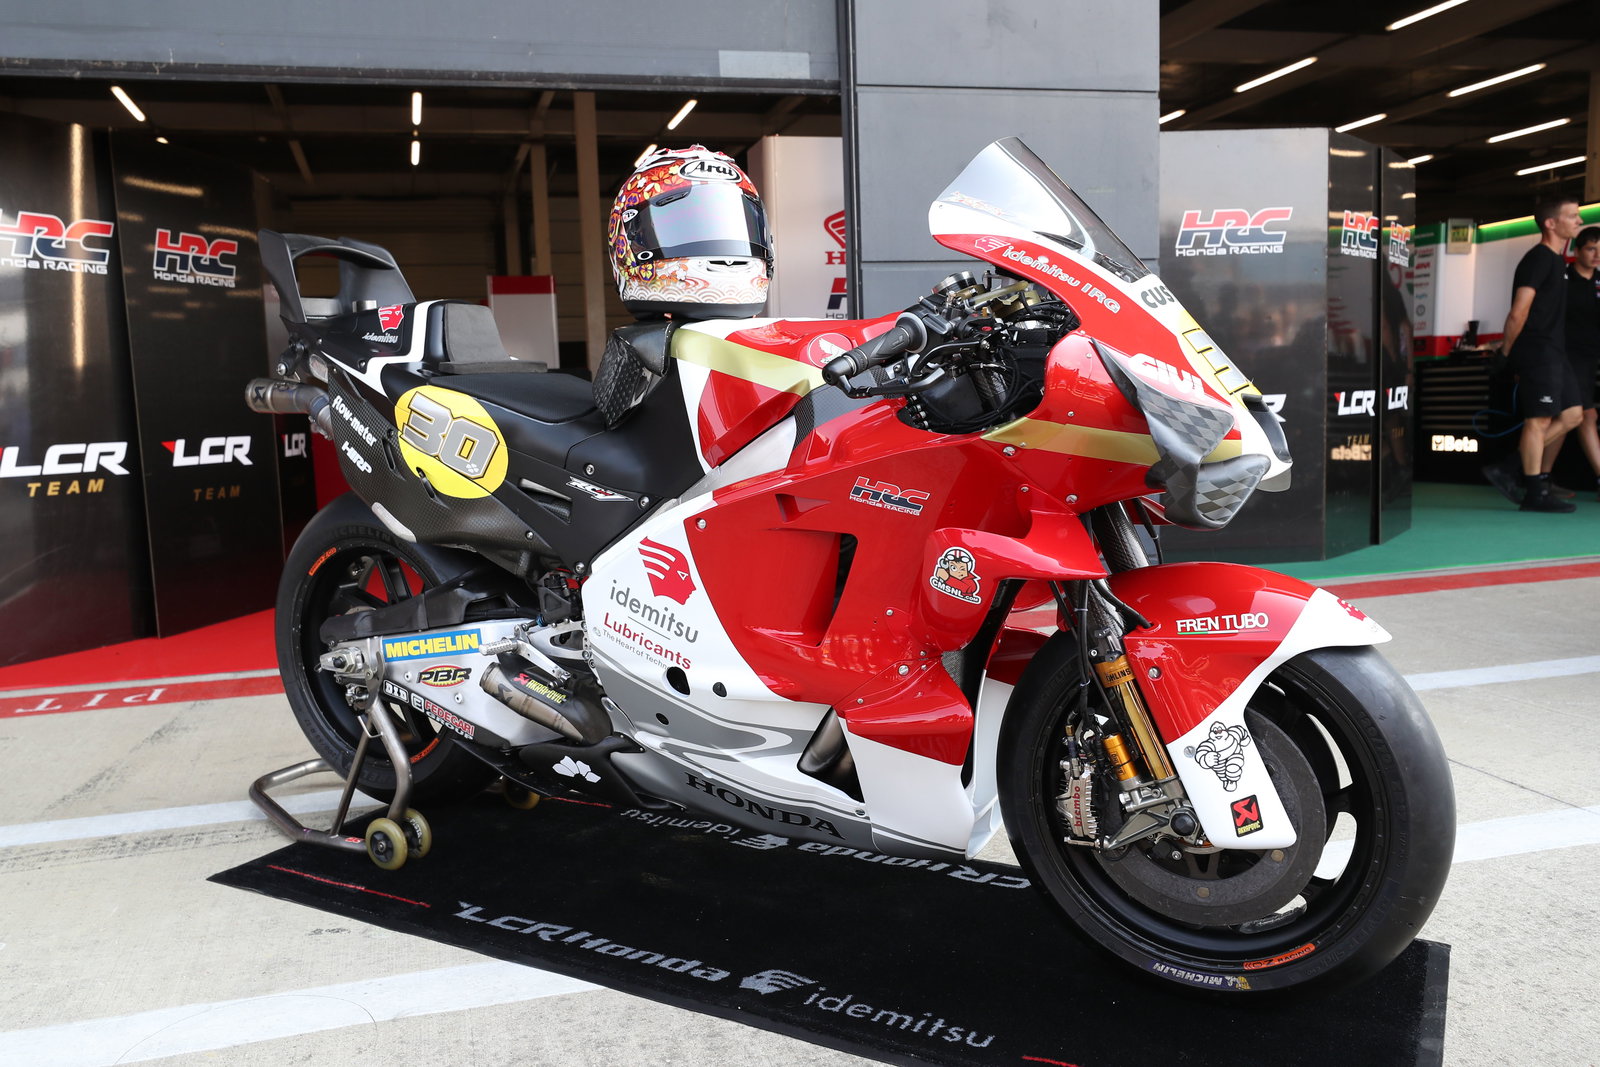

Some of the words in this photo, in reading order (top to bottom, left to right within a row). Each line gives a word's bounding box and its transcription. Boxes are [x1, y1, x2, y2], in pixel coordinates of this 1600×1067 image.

[686, 161, 734, 177] Arai
[1175, 206, 1293, 249] HRC
[1340, 210, 1379, 251] HRC
[153, 228, 238, 279] HRC
[1176, 247, 1227, 257] Honda
[1229, 245, 1284, 255] RACING
[43, 259, 108, 275] RACING
[154, 270, 195, 284] Honda
[196, 275, 236, 288] RACING
[1002, 245, 1081, 287] idemitsu
[1081, 283, 1121, 314] IRG
[362, 331, 399, 344] idemitsu
[1338, 390, 1376, 417] LCR
[1388, 386, 1409, 411] LCR
[332, 395, 377, 447] flow-meter
[284, 433, 307, 459] LCR
[400, 391, 500, 480] 30
[0, 442, 130, 478] LCR
[172, 436, 253, 467] LCR
[27, 478, 105, 498] TEAM
[193, 485, 241, 501] TEAM
[850, 476, 930, 512] HRC
[850, 495, 882, 508] Honda
[883, 503, 920, 516] RACING
[609, 579, 699, 643] idemitsu
[1176, 614, 1220, 632] FREN
[1222, 612, 1269, 630] TUBO
[384, 633, 480, 659] MICHELIN
[602, 629, 615, 642] The
[615, 637, 636, 655] Heart
[604, 612, 692, 670] Lubricants
[416, 667, 472, 683] PBR
[14, 688, 167, 713] PIT
[425, 700, 475, 736] FEDEGARI
[426, 711, 474, 740] GROUP
[684, 771, 846, 840] HONDA
[1073, 786, 1082, 827] brembo
[620, 808, 742, 840] idemitsu
[797, 840, 1032, 890] CRHonda
[1277, 946, 1312, 964] RACING
[1153, 962, 1224, 986] MICHELIN
[803, 986, 996, 1048] idemitsu
